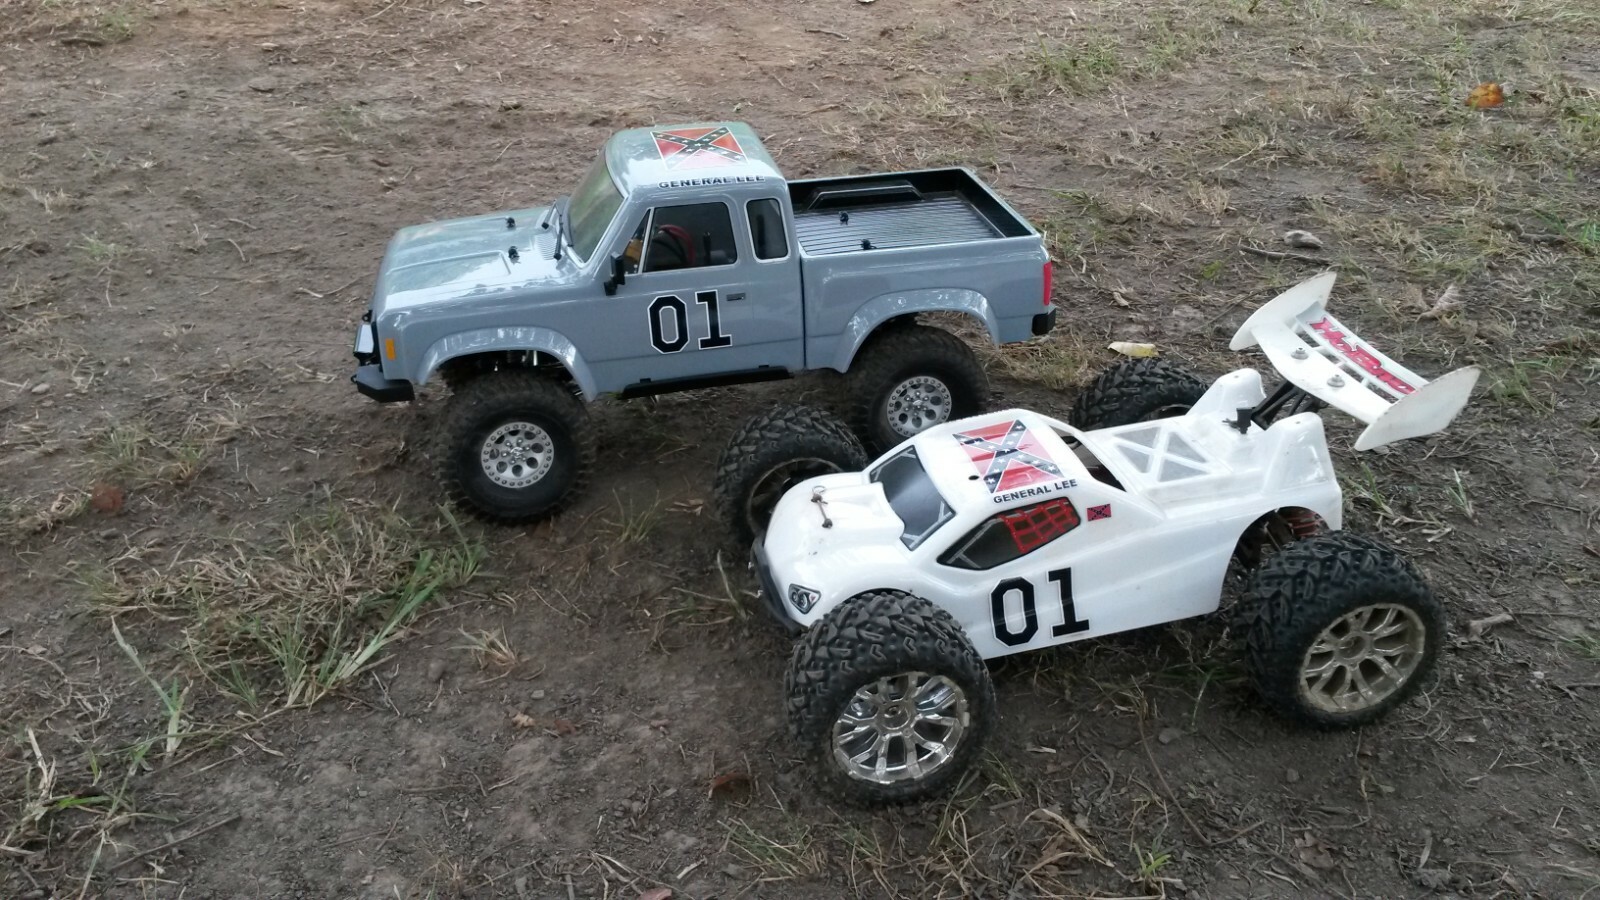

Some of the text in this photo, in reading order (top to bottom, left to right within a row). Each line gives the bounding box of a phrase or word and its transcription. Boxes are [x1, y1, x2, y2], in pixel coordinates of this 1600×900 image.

[658, 175, 765, 188] GENERAL LEE
[648, 290, 732, 354] 01
[993, 478, 1078, 504] GENERAL LEE
[990, 566, 1090, 647] 01
